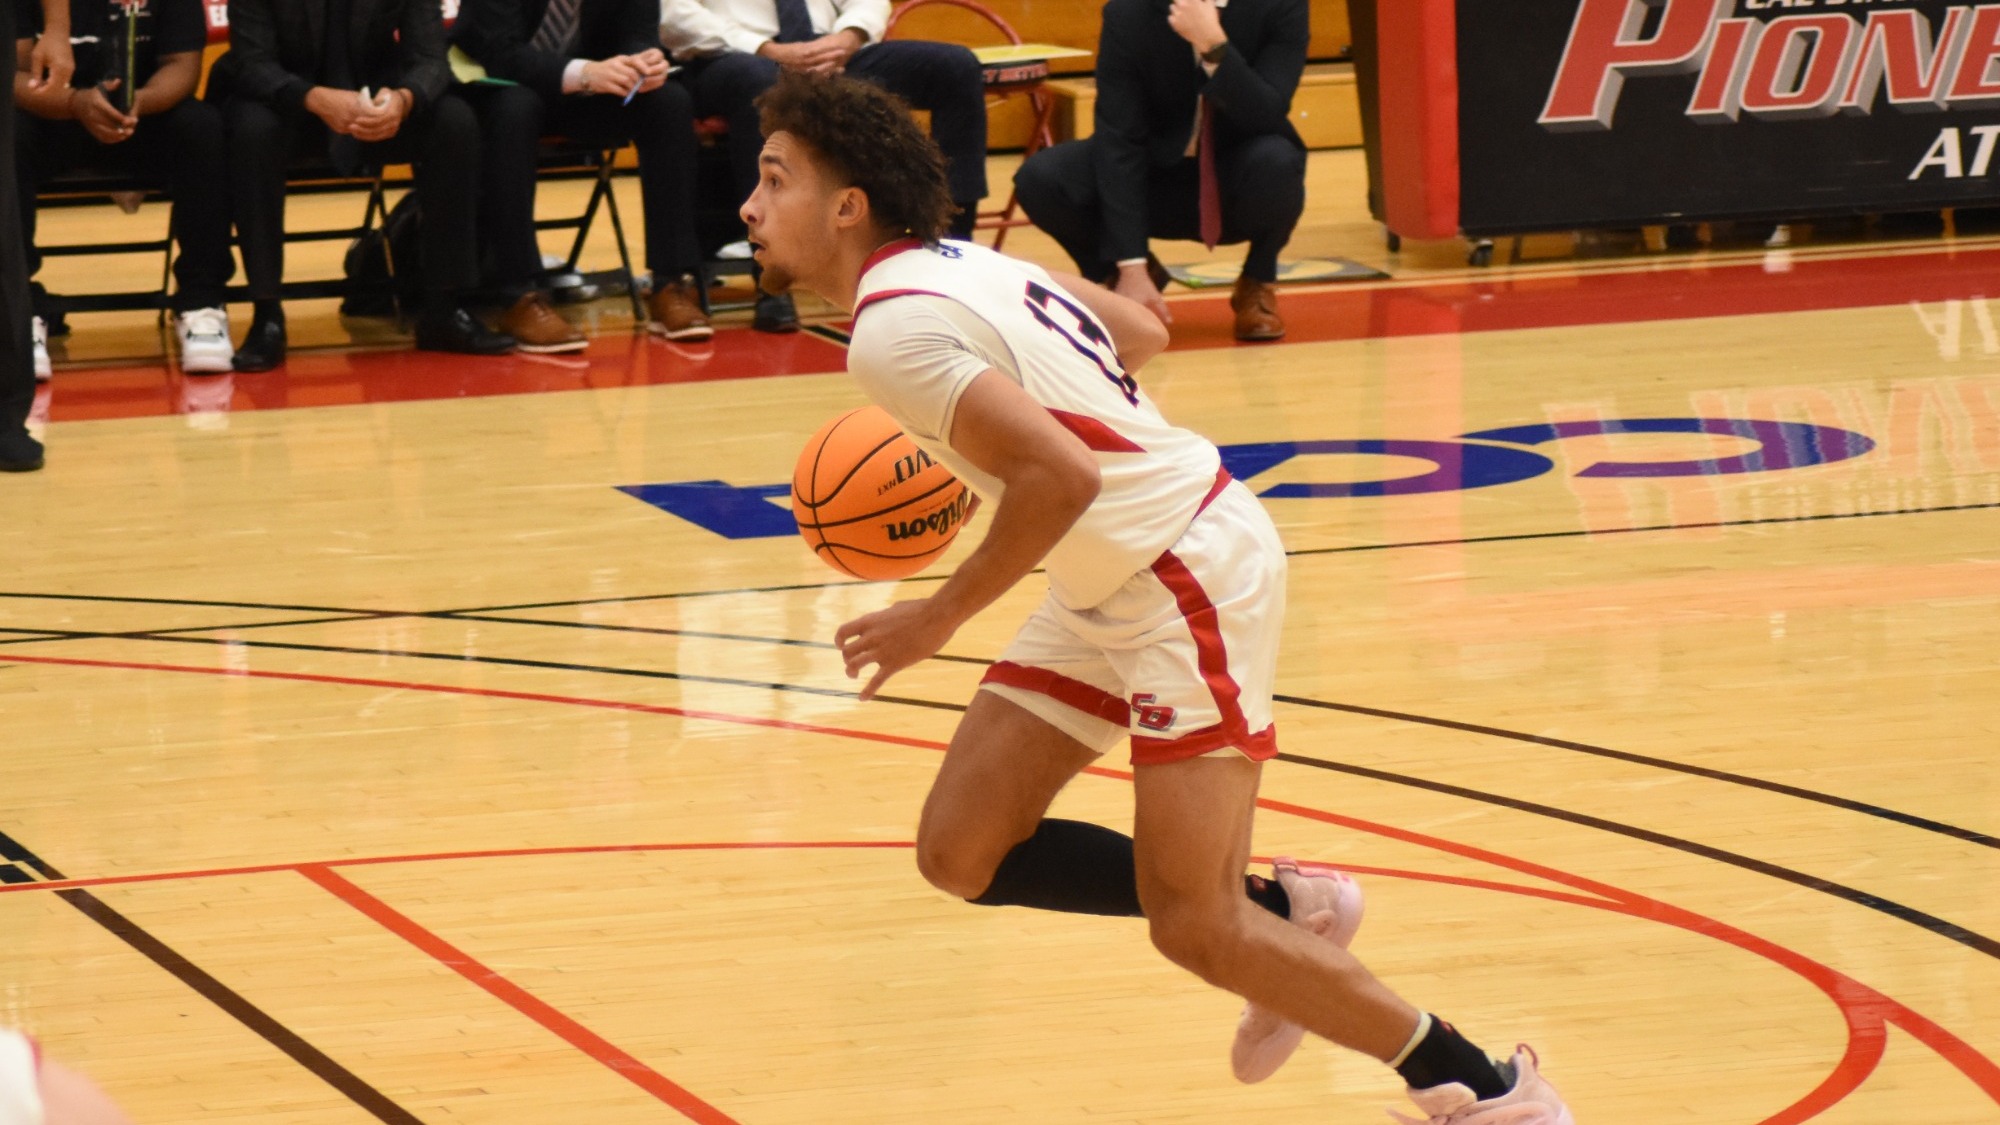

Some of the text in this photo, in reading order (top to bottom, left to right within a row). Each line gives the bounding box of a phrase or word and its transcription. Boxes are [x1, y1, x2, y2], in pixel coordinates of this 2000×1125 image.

[1907, 125, 2000, 180] AT
[894, 448, 938, 483] VO
[877, 479, 897, 496] NXT
